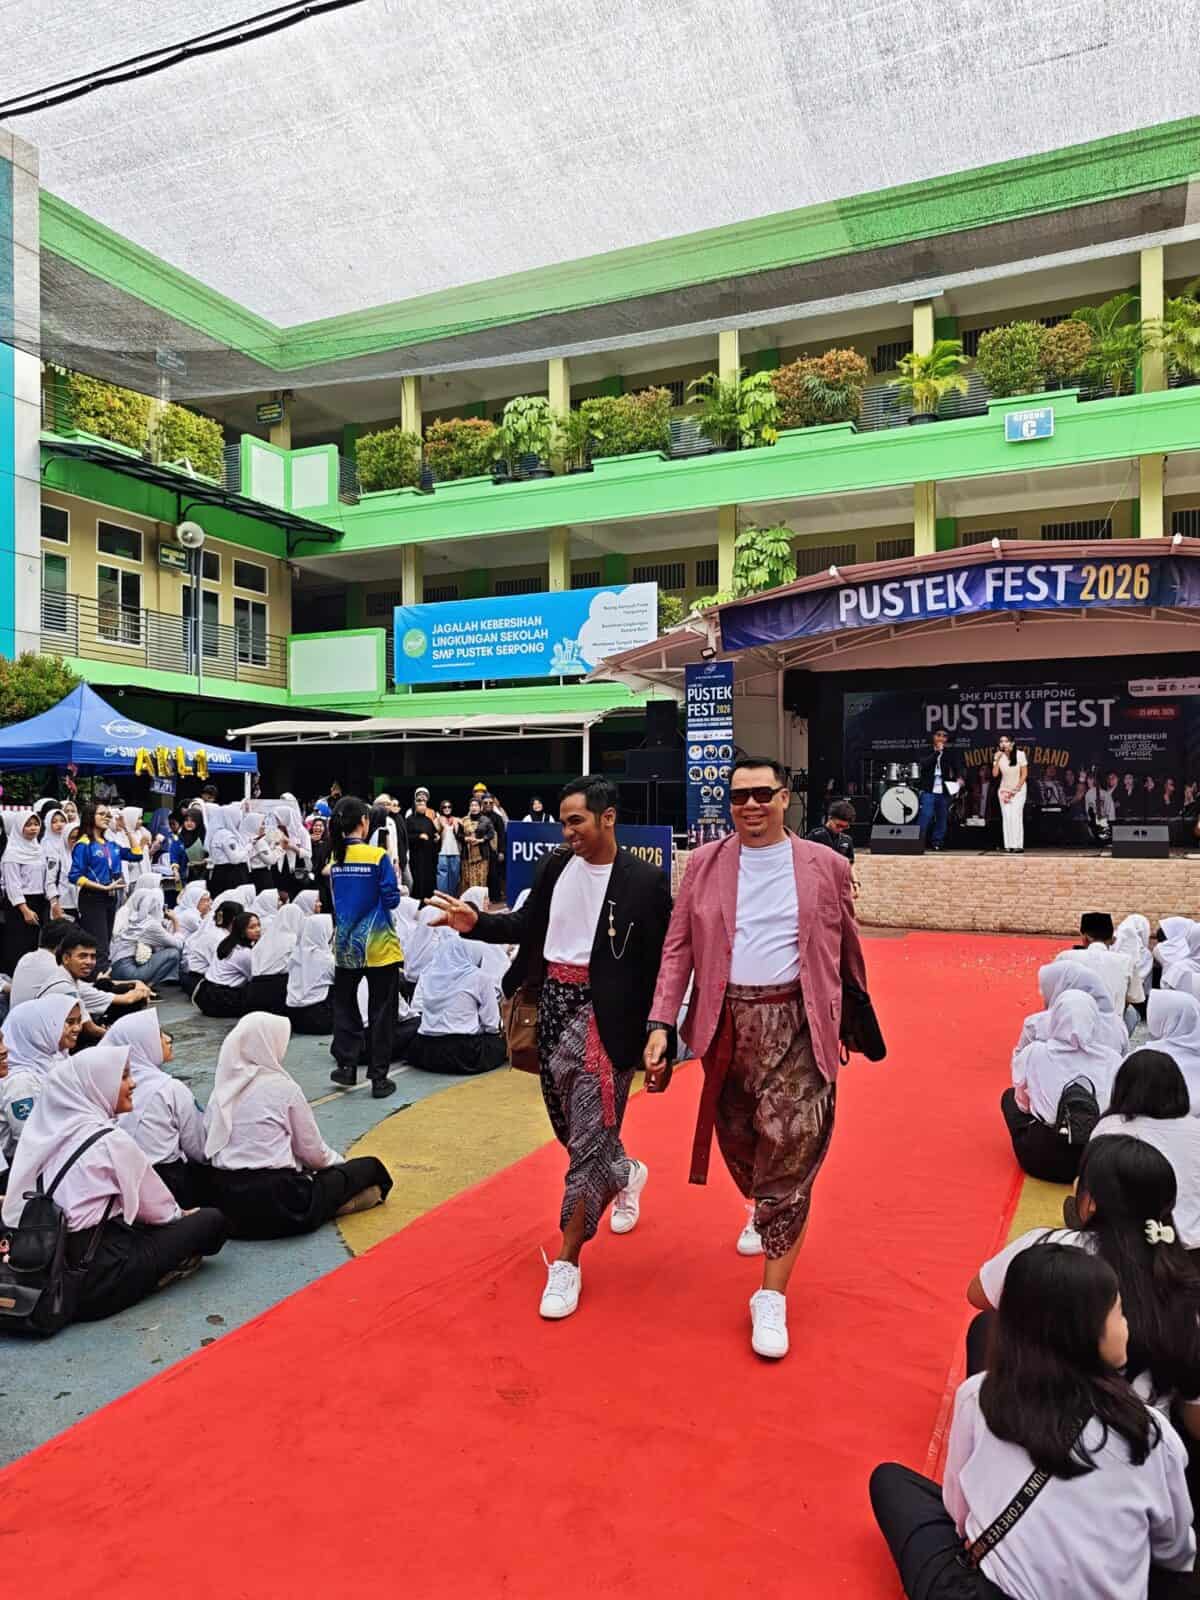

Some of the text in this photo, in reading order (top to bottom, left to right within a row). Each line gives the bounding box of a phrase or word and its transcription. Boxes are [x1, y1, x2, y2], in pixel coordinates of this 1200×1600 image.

[1022, 420, 1037, 437] C
[839, 563, 1150, 622] PUSTEK FEST 2026
[432, 616, 542, 635] JAGALAH KEBERSIHAN
[432, 633, 498, 647] LINGKUNGAN
[500, 629, 549, 642] SEKOLAH
[432, 642, 544, 660] SMP PUSTEK SERPONG
[687, 686, 733, 702] PUSTEK
[959, 688, 1076, 702] SMK PUSTEK SERPONG
[687, 702, 715, 717] FEST
[926, 699, 1116, 732] PUSTEK FEST
[1033, 748, 1071, 768] BAND
[985, 1500, 1024, 1544] FOREVER
